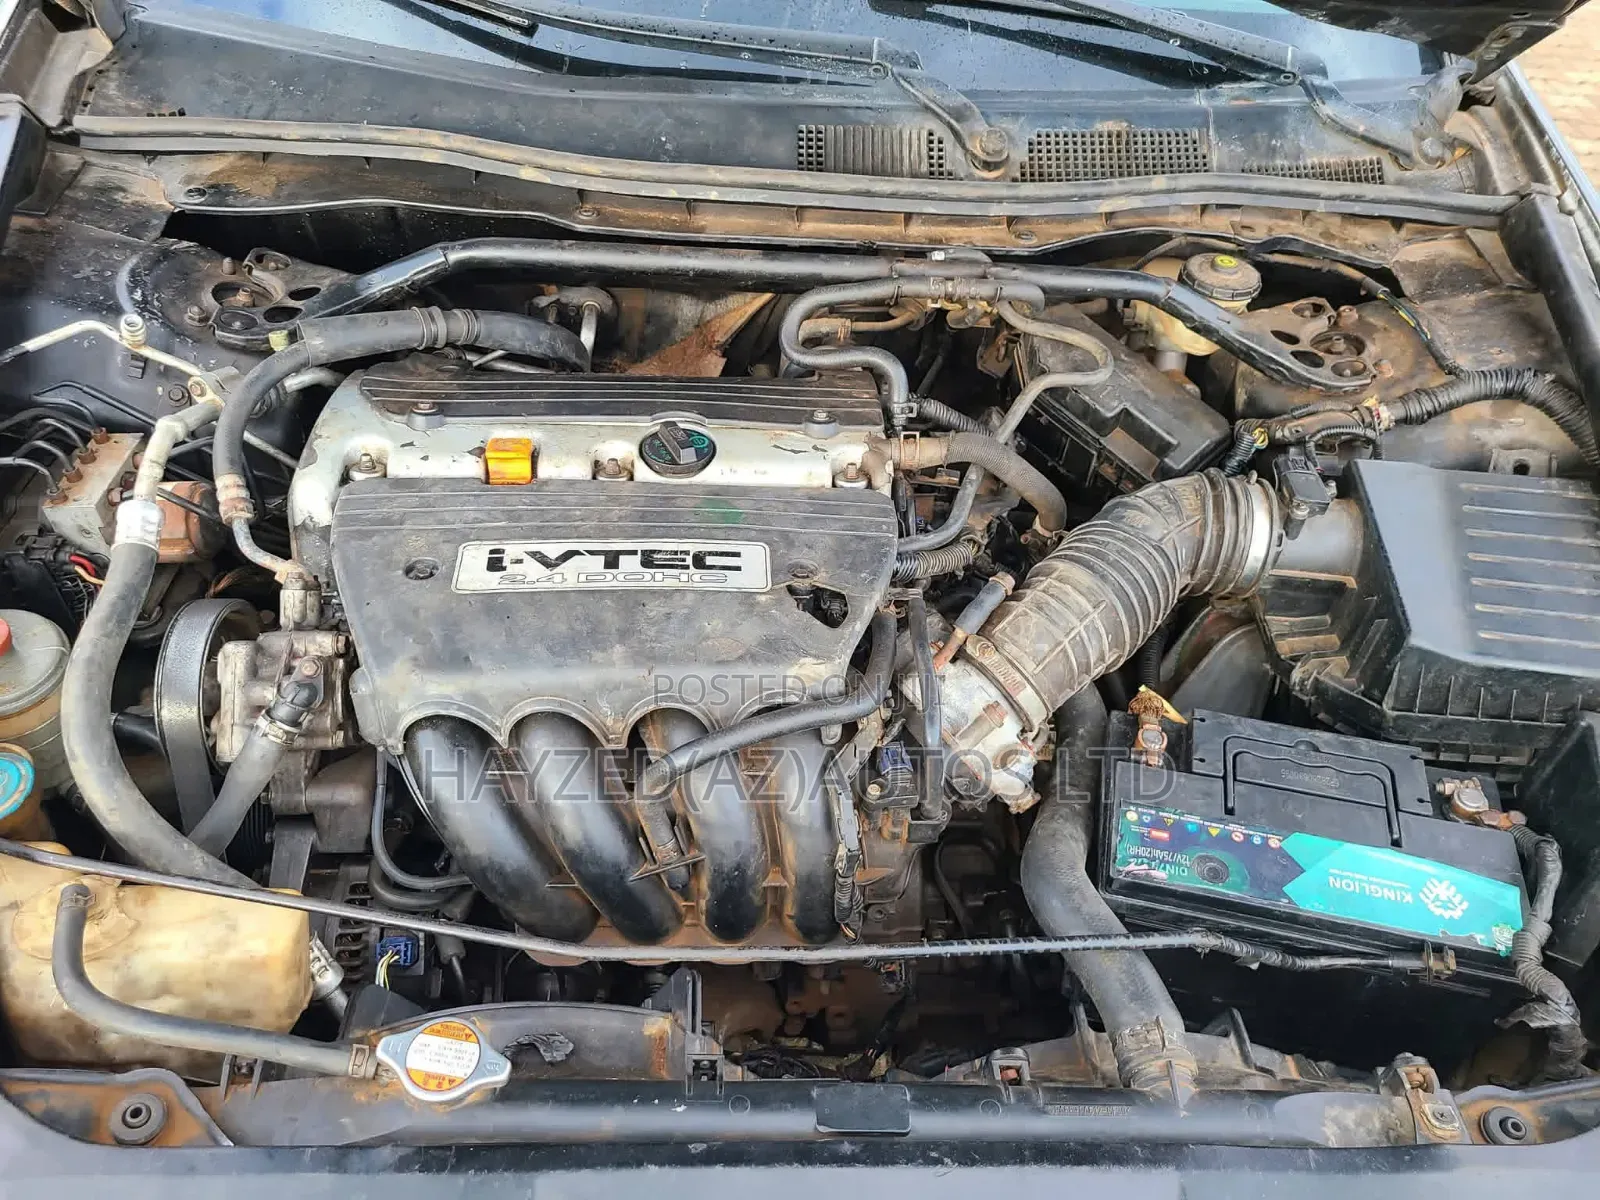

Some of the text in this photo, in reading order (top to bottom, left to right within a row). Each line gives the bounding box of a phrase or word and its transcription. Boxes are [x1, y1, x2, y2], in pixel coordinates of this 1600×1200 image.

[486, 548, 742, 573] i-VTEC
[498, 571, 728, 585] 2.4 DOHC
[1328, 875, 1413, 904] KINGLION
